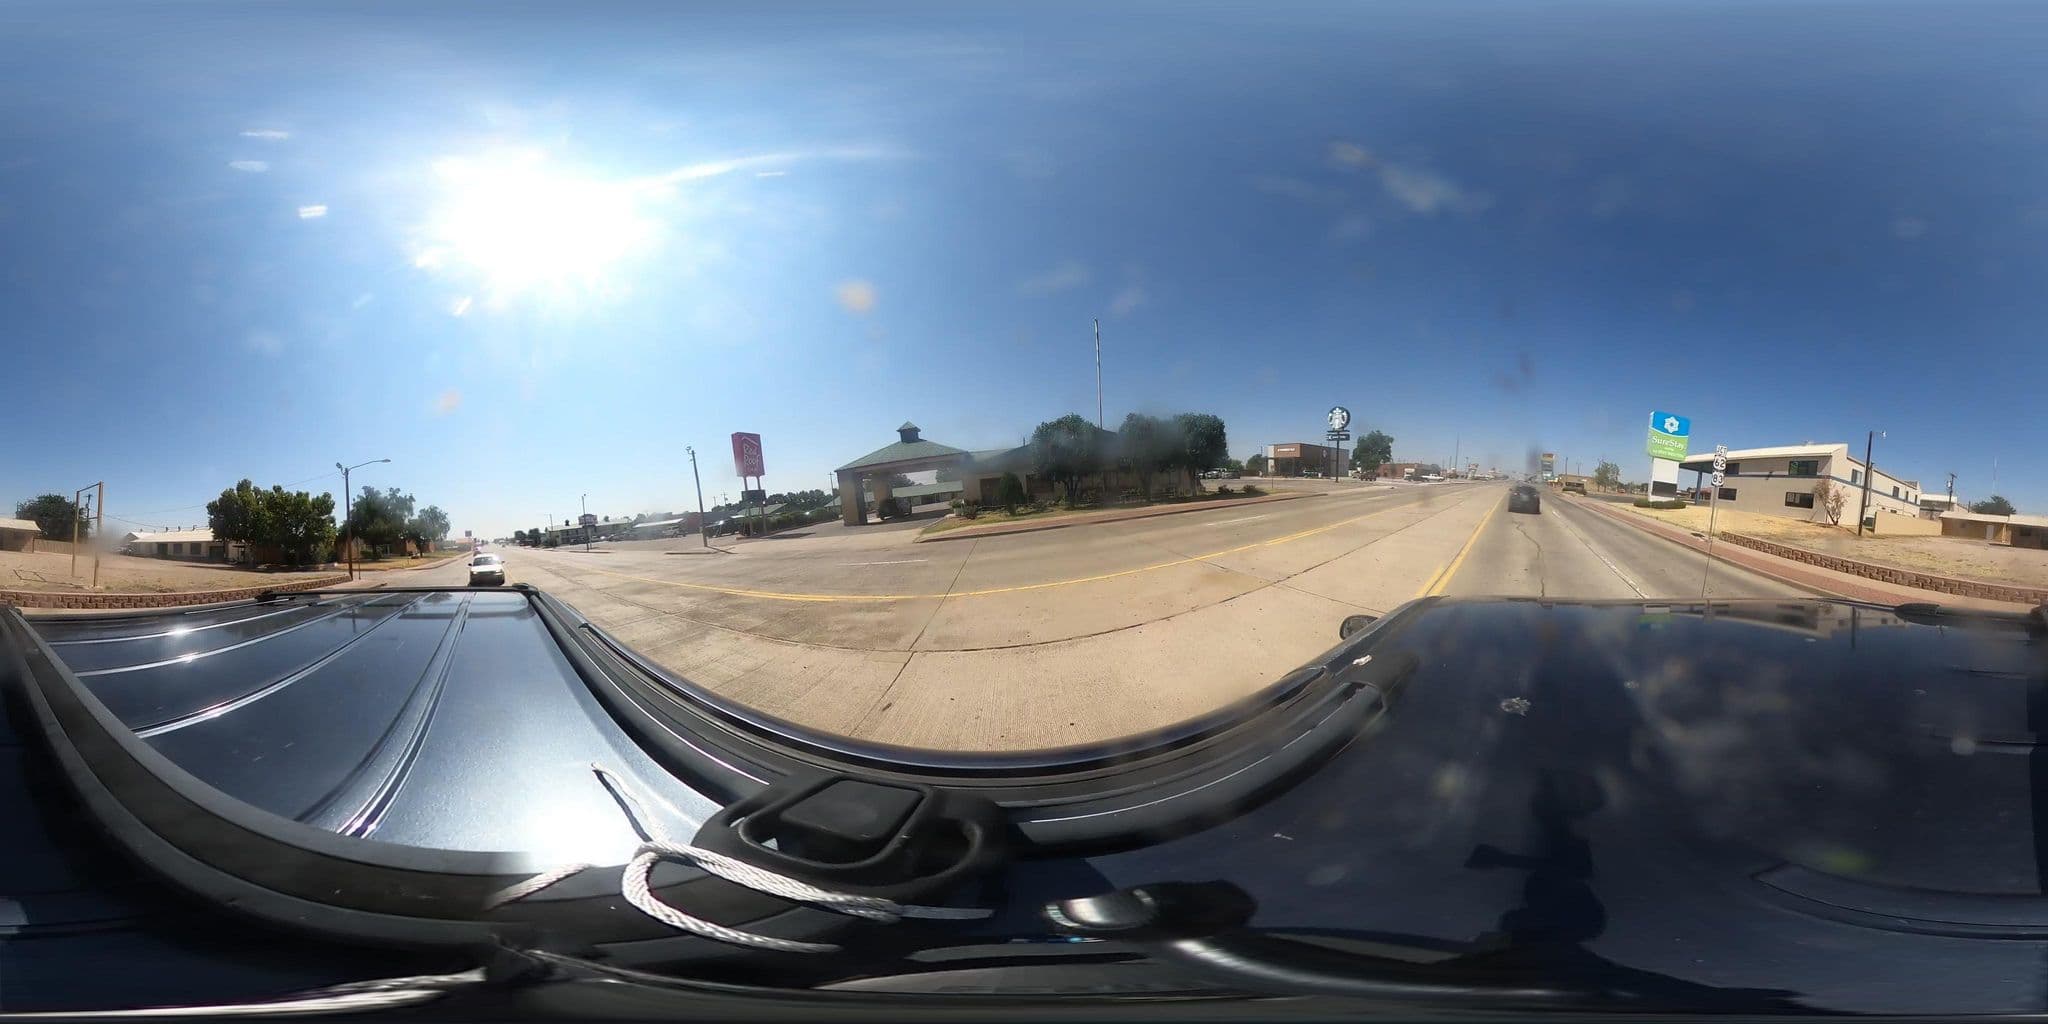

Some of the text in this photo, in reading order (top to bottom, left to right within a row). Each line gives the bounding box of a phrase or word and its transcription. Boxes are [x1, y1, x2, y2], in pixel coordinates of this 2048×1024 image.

[1652, 436, 1684, 451] SureStay
[1714, 458, 1725, 468] 62
[1713, 474, 1723, 484] 83
